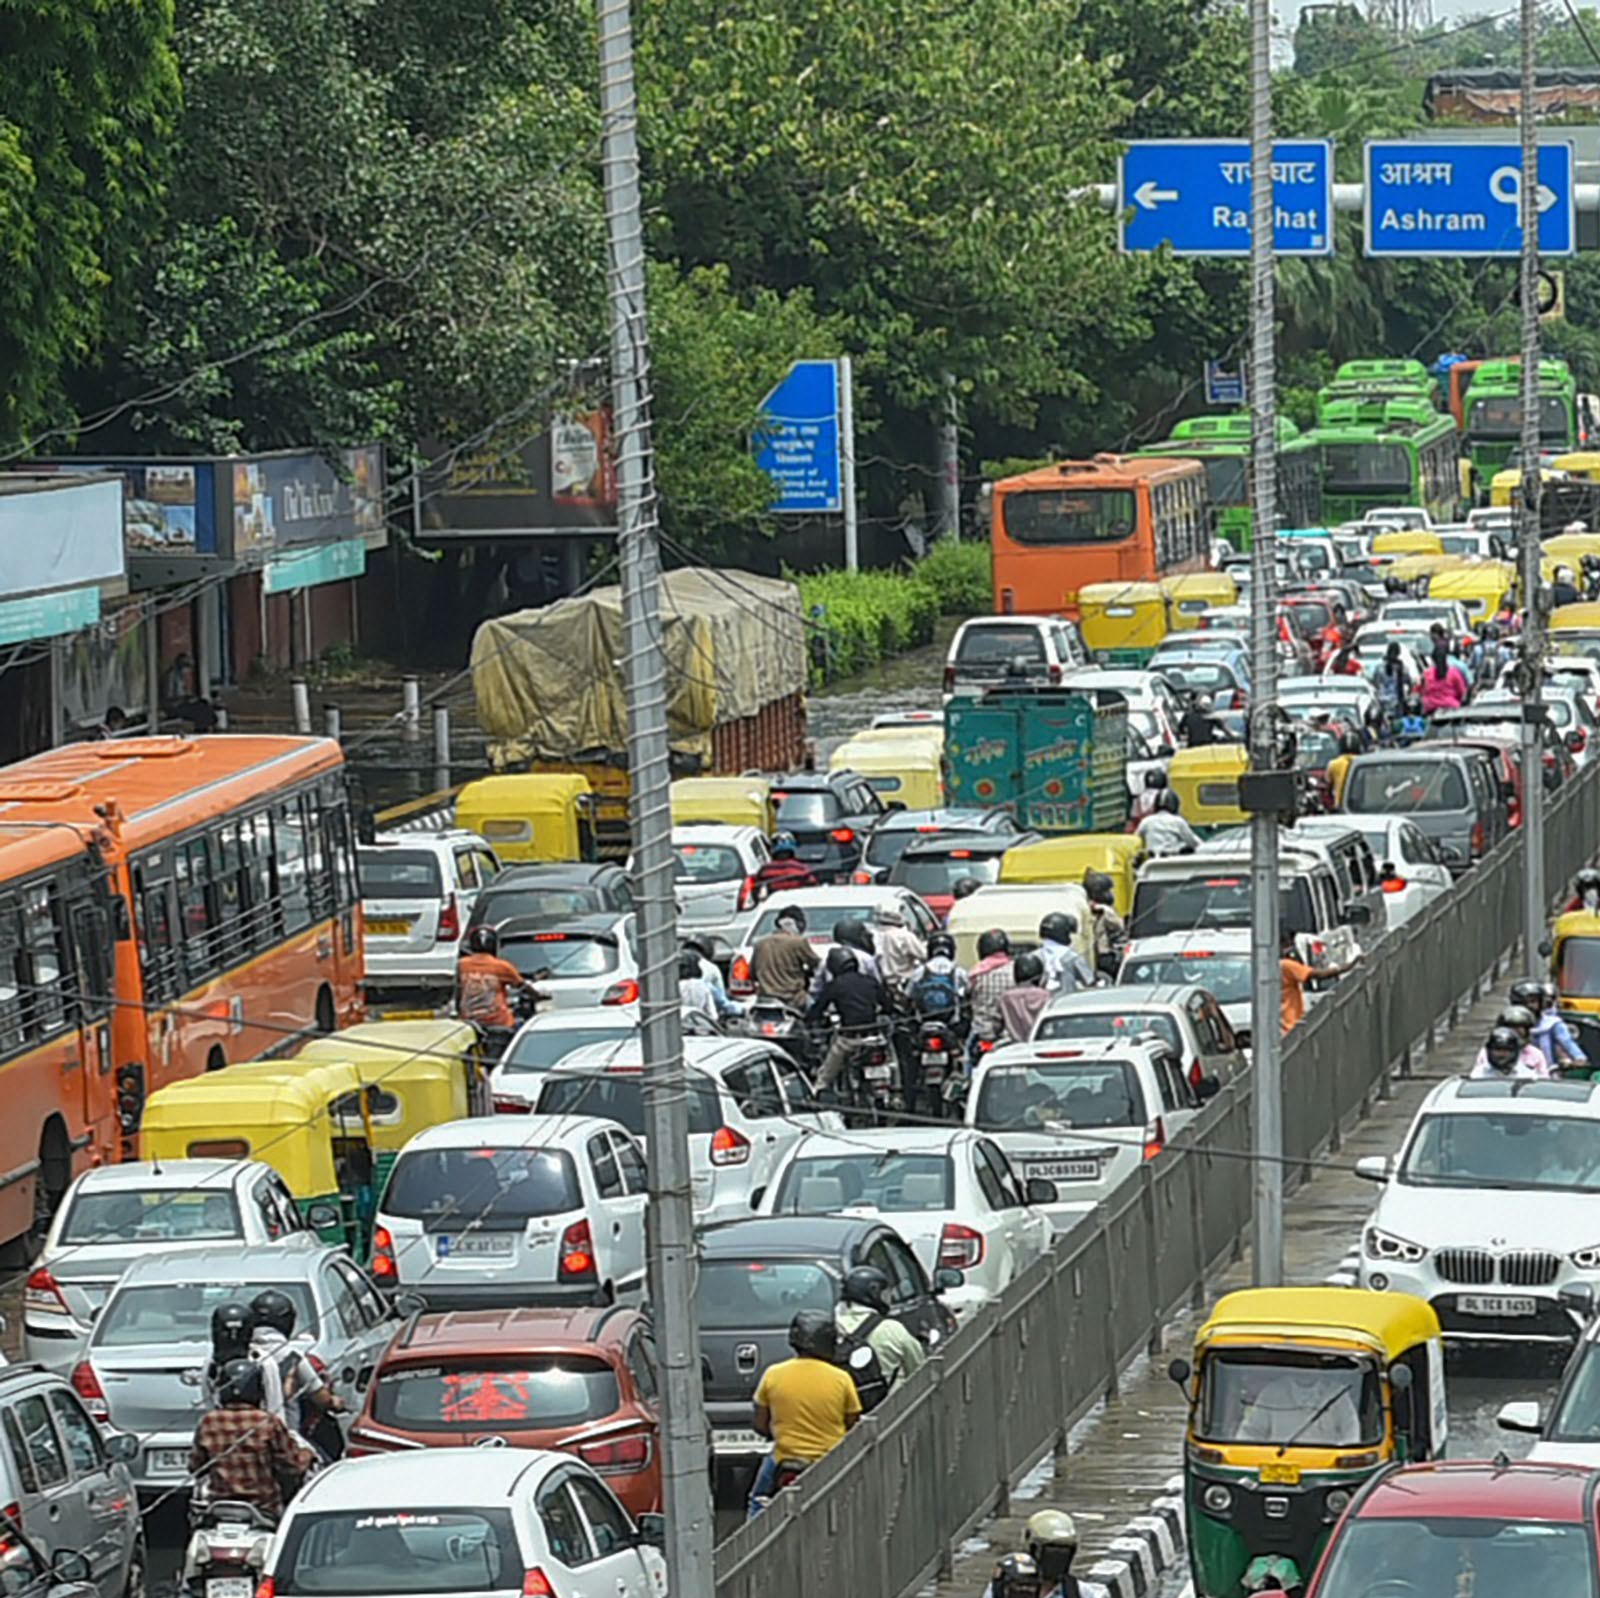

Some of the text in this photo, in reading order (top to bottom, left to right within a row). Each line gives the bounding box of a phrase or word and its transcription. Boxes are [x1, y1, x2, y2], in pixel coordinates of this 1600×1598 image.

[1379, 163, 1452, 185] आश्रम
[1213, 206, 1317, 233] Rahat
[1380, 208, 1485, 231] Ashram
